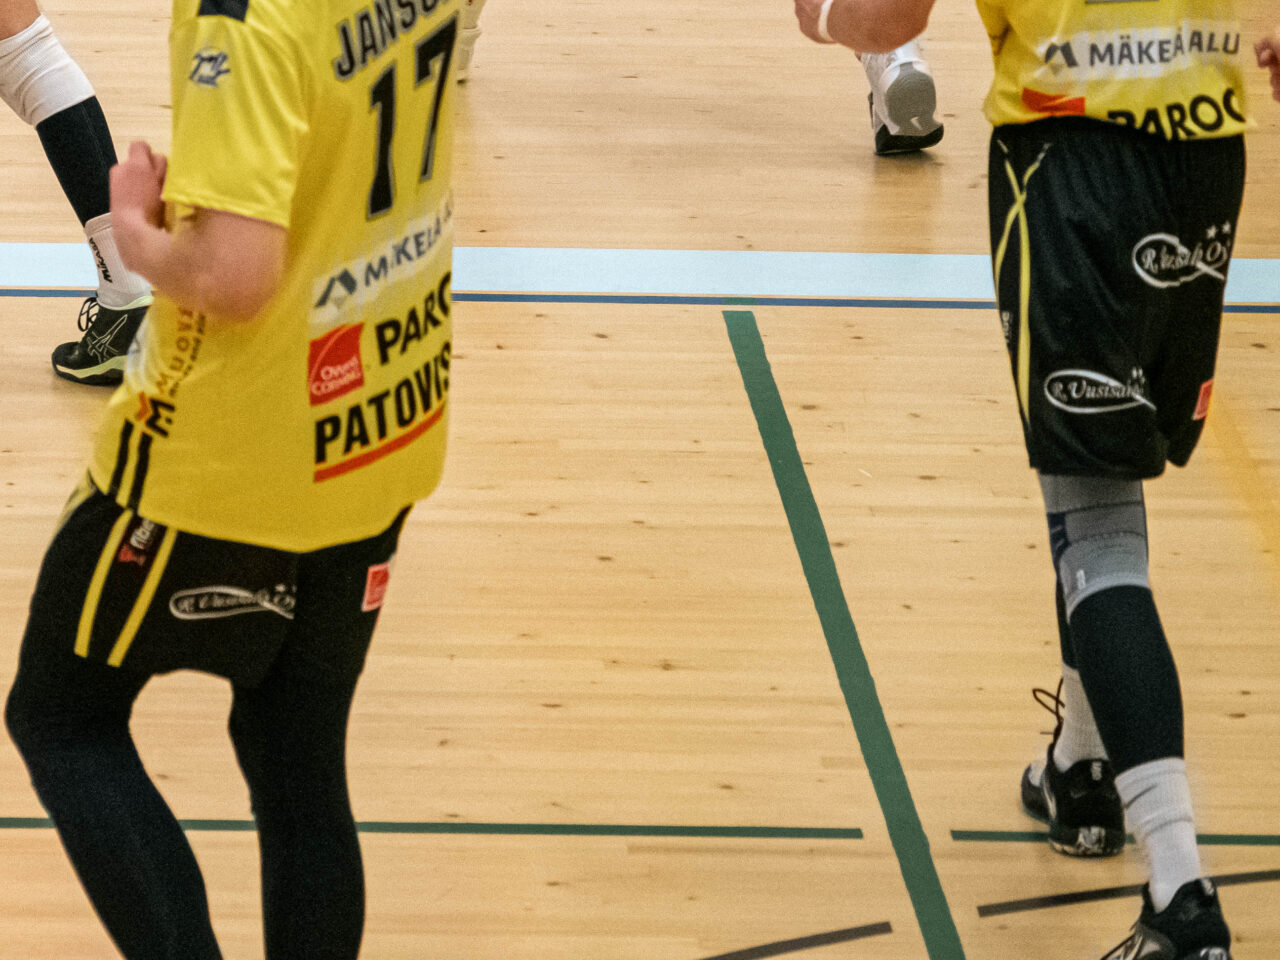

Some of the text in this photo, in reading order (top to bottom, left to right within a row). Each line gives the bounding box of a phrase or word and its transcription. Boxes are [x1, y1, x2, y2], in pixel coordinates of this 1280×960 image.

[1089, 26, 1240, 67] MÄKEÄ ALU
[366, 9, 460, 222] 17
[375, 271, 451, 366] PARO
[315, 341, 451, 464] PATOVIS
